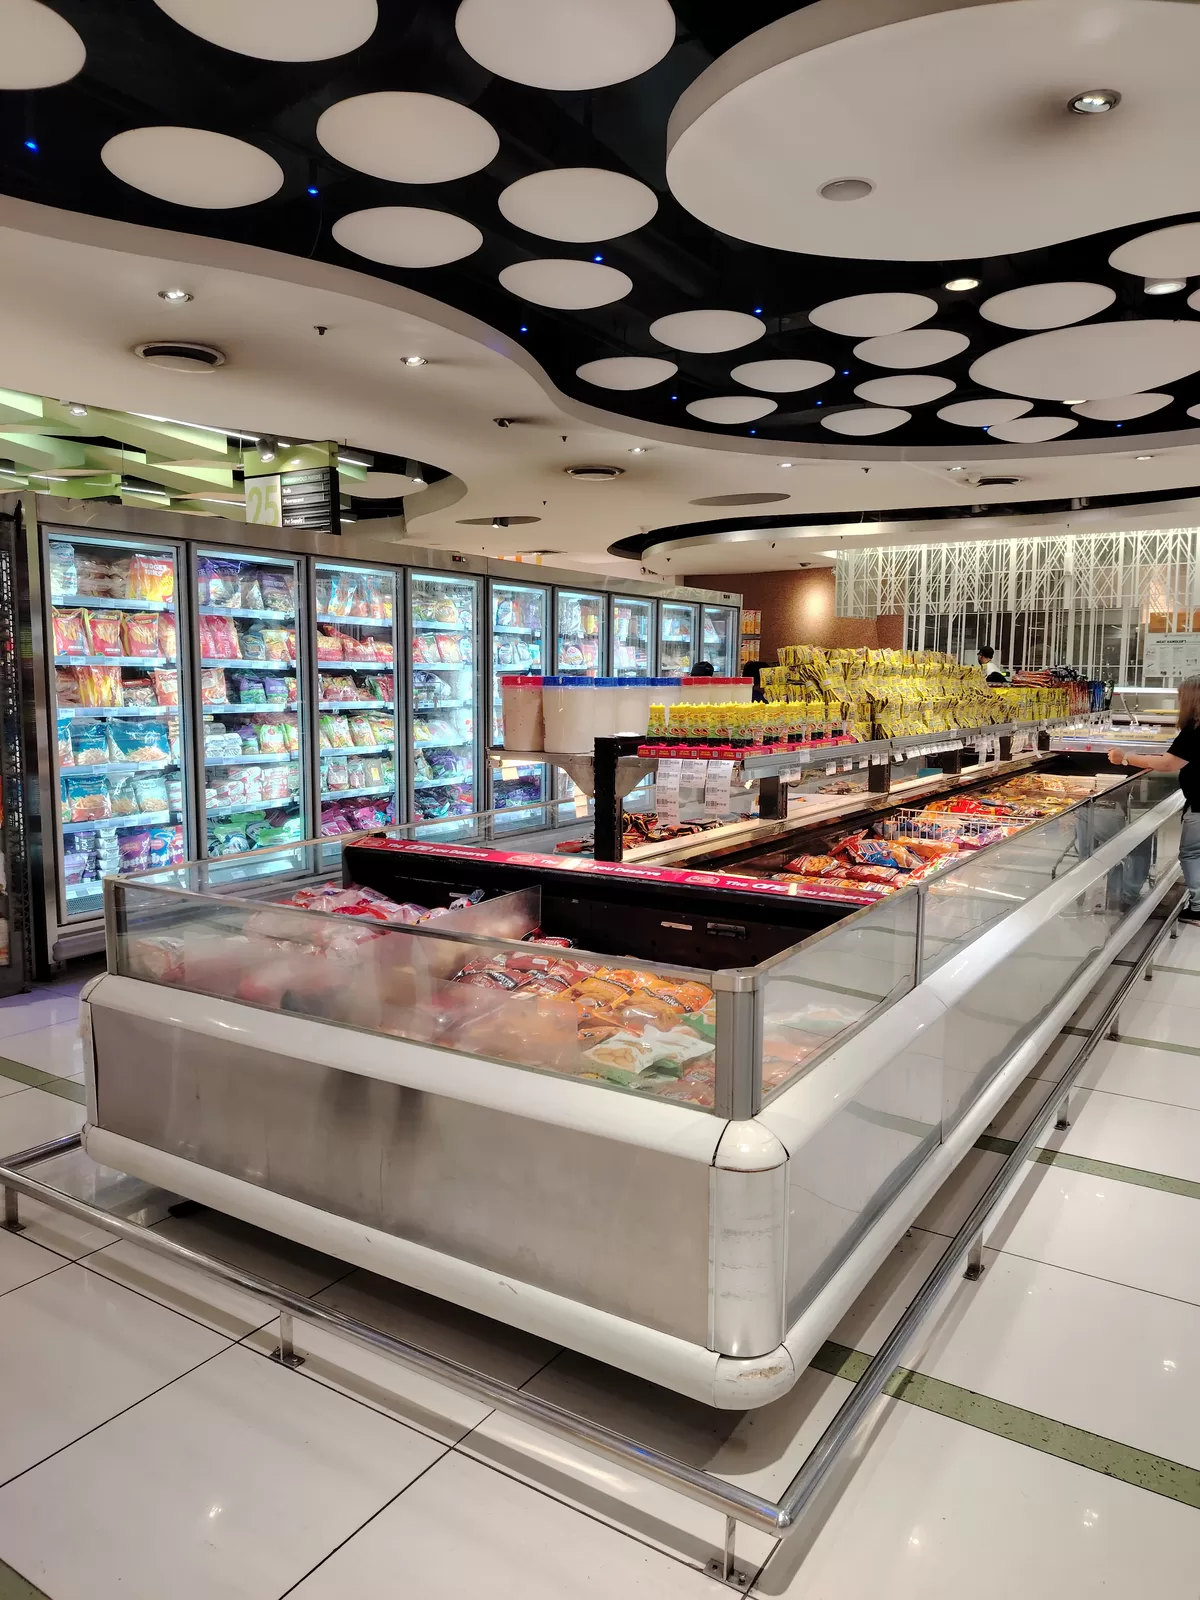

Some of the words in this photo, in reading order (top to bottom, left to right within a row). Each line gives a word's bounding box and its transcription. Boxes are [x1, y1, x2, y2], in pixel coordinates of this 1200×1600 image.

[248, 485, 279, 526] 25
[450, 849, 489, 858] Deserve
[592, 864, 616, 872] you
[614, 867, 662, 877] Deserve
[725, 879, 749, 888] The
[818, 890, 878, 903] Deserve
